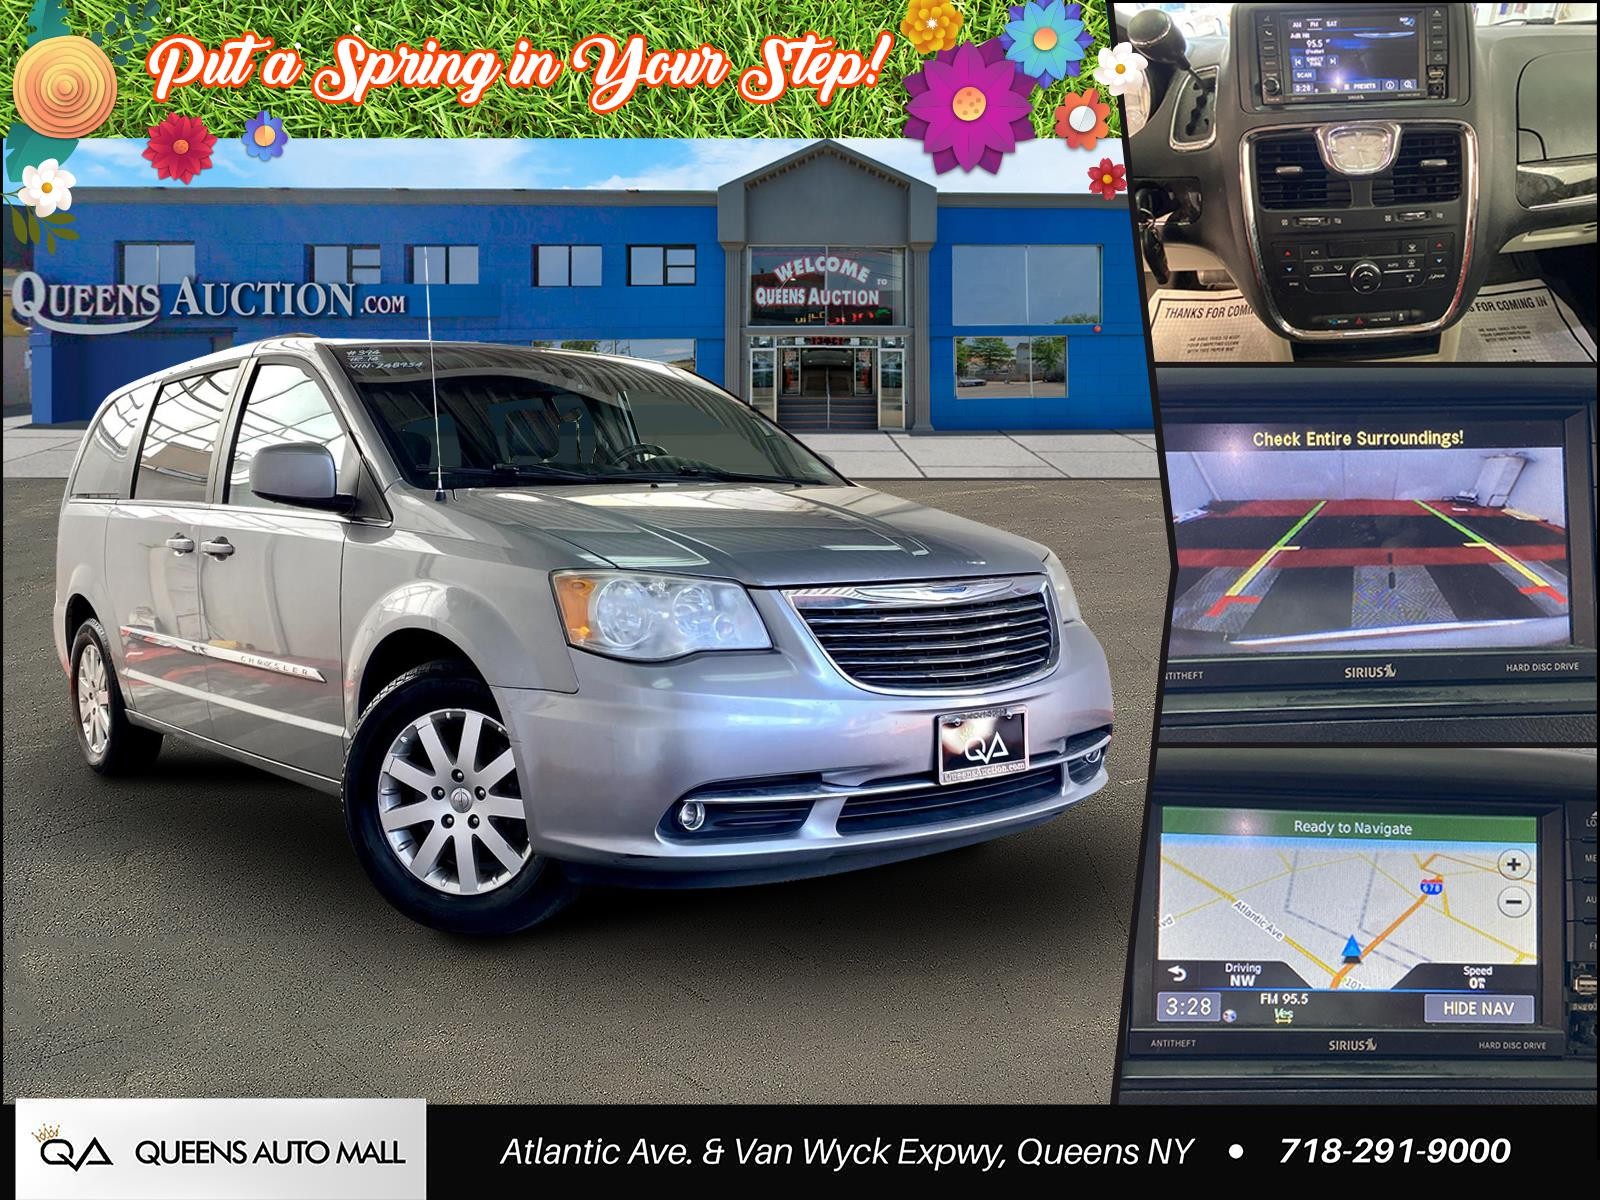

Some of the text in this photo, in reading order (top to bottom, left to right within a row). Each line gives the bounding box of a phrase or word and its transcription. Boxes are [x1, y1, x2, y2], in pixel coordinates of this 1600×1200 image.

[1306, 39, 1324, 48] 95.5
[774, 256, 888, 286] WELCOME TO
[755, 287, 879, 305] QUEENS AUCTION
[9, 271, 161, 335] QUEENS
[1476, 301, 1497, 313] FOR
[1496, 297, 1536, 311] COMING
[1536, 295, 1549, 307] IN
[1165, 307, 1204, 319] THANKS
[1205, 307, 1225, 319] FOR
[1253, 429, 1464, 449] Check Entire Surroundings!
[1344, 666, 1384, 678] SIRIUS
[1506, 661, 1580, 672] HARD DISC DRIVE
[1294, 820, 1413, 838] Ready to Navigate
[1422, 884, 1441, 893] 678
[1233, 900, 1284, 940] Atlantic Ave
[1225, 963, 1262, 975] Driving
[1463, 966, 1493, 976] Speed
[1230, 975, 1256, 987] NW
[1260, 993, 1309, 1005] FM 95.5
[1165, 997, 1212, 1016] 3:28
[1443, 1001, 1515, 1016] HIDE NAV
[1151, 1039, 1197, 1048] ANTITHEFT
[1329, 1040, 1366, 1051] SIRIUS
[1479, 1041, 1547, 1050] HARD DISC DRIVE
